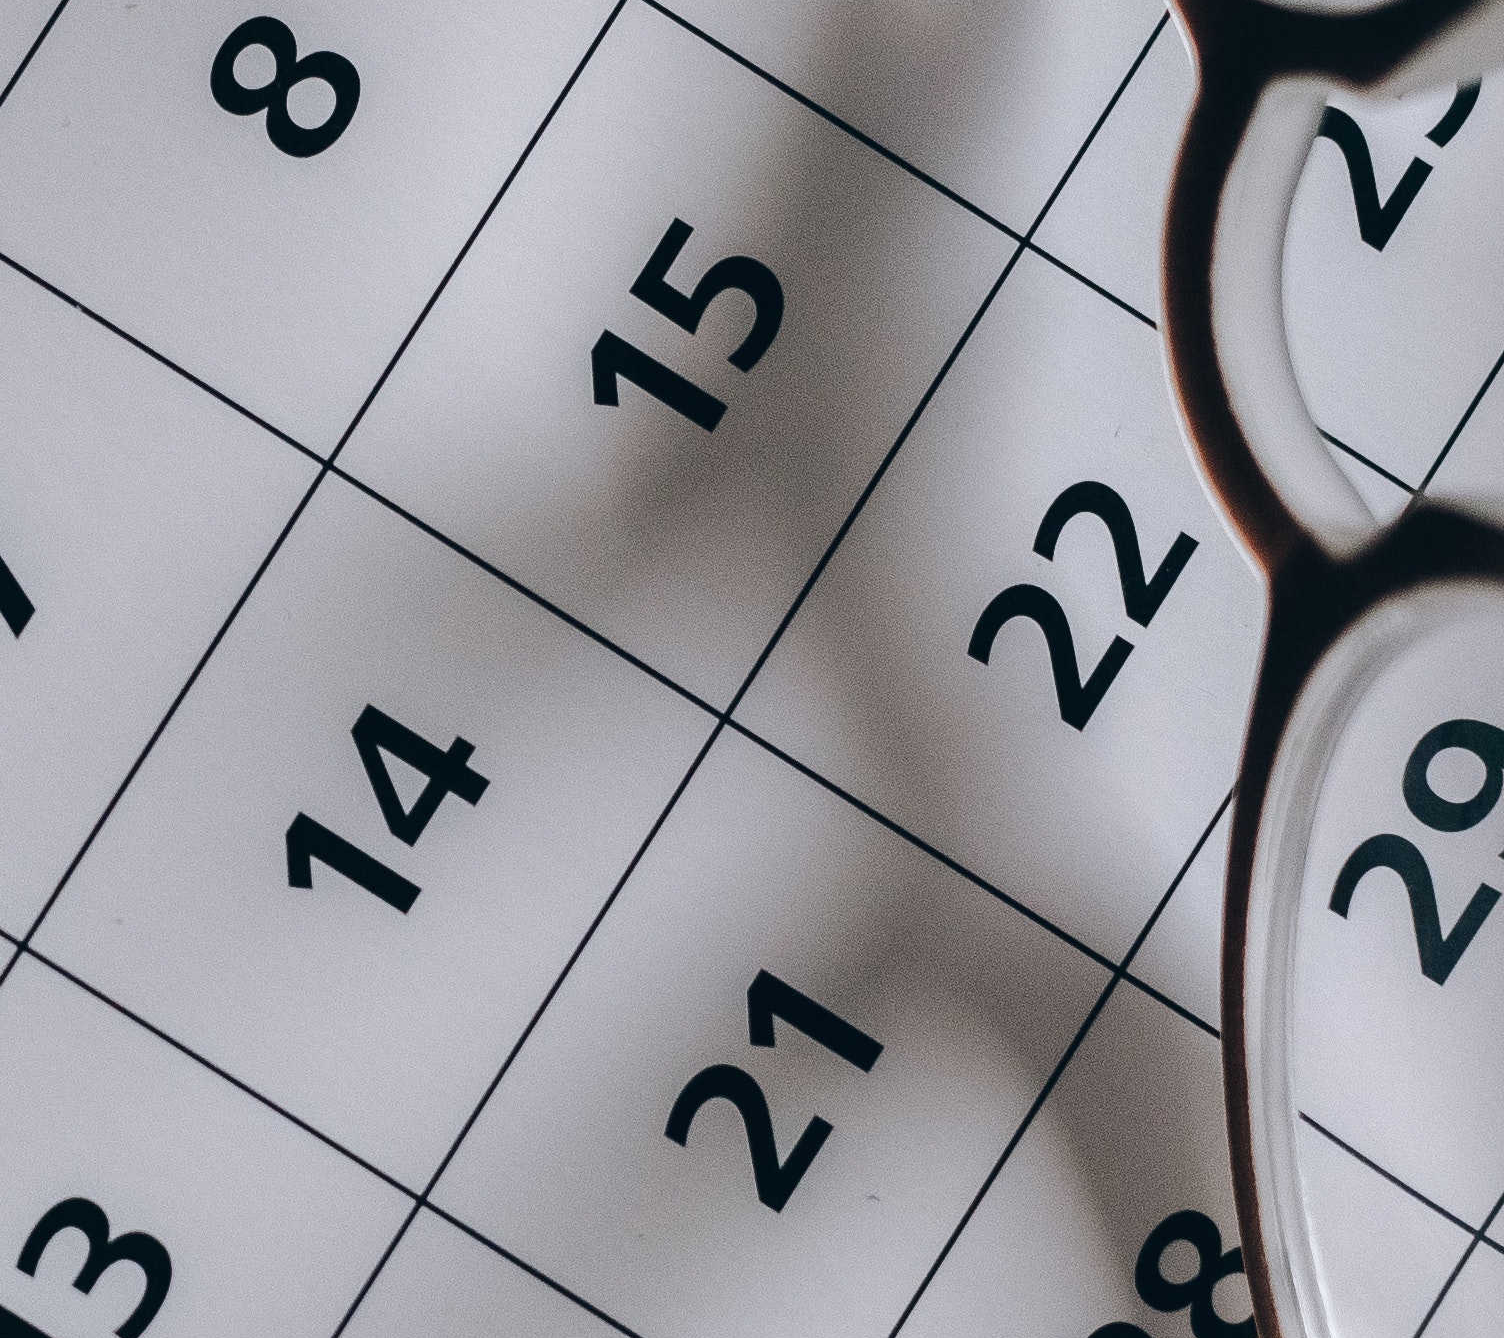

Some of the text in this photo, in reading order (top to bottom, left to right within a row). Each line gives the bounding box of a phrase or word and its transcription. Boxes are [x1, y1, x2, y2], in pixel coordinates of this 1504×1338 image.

[211, 16, 360, 158] 8
[591, 217, 784, 433] 15
[967, 481, 1199, 732] 22
[286, 703, 490, 914] 14
[664, 969, 884, 1213] 21
